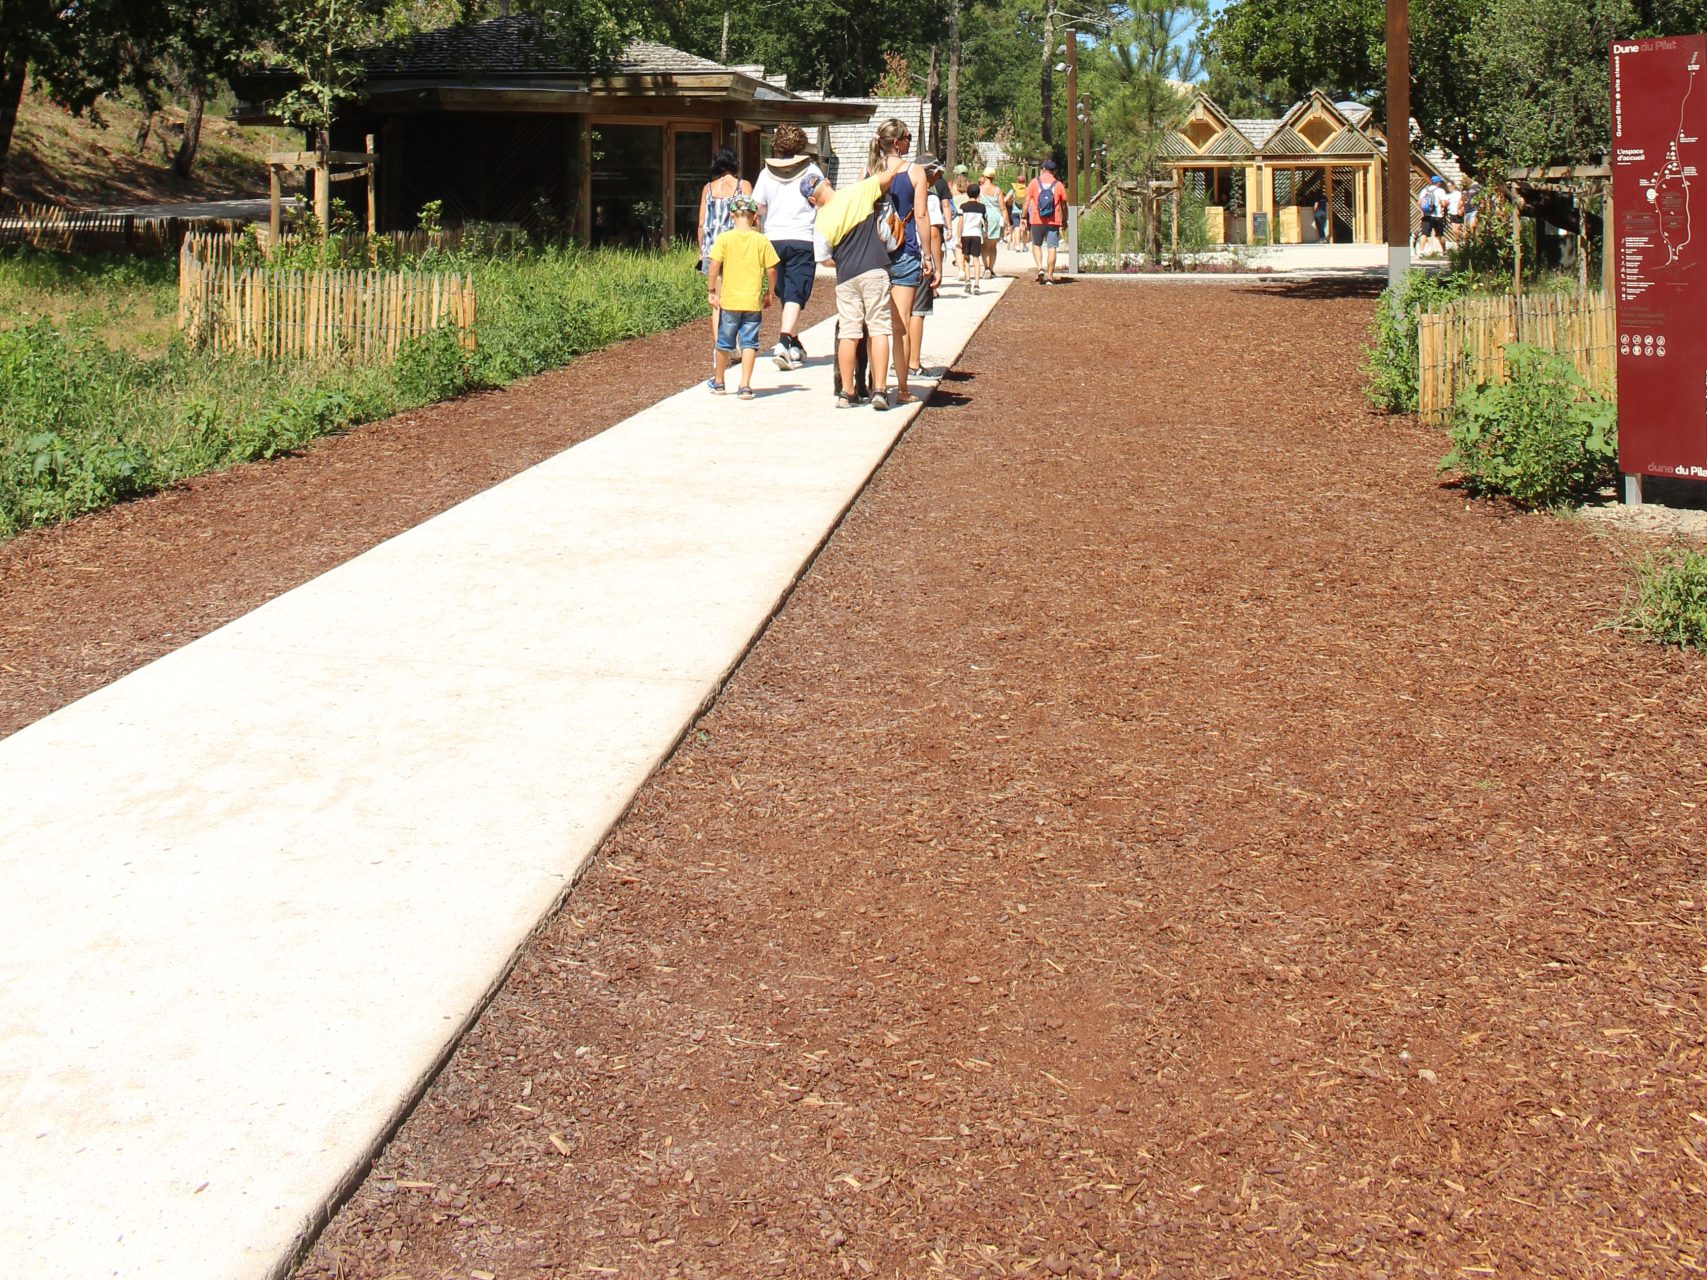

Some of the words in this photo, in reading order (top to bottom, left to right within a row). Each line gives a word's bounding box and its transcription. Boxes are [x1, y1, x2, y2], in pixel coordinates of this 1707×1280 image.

[1613, 45, 1639, 54] Dune
[1640, 42, 1653, 51] du
[1655, 40, 1677, 50] Pilat
[1647, 462, 1673, 473] dune
[1675, 465, 1688, 475] du
